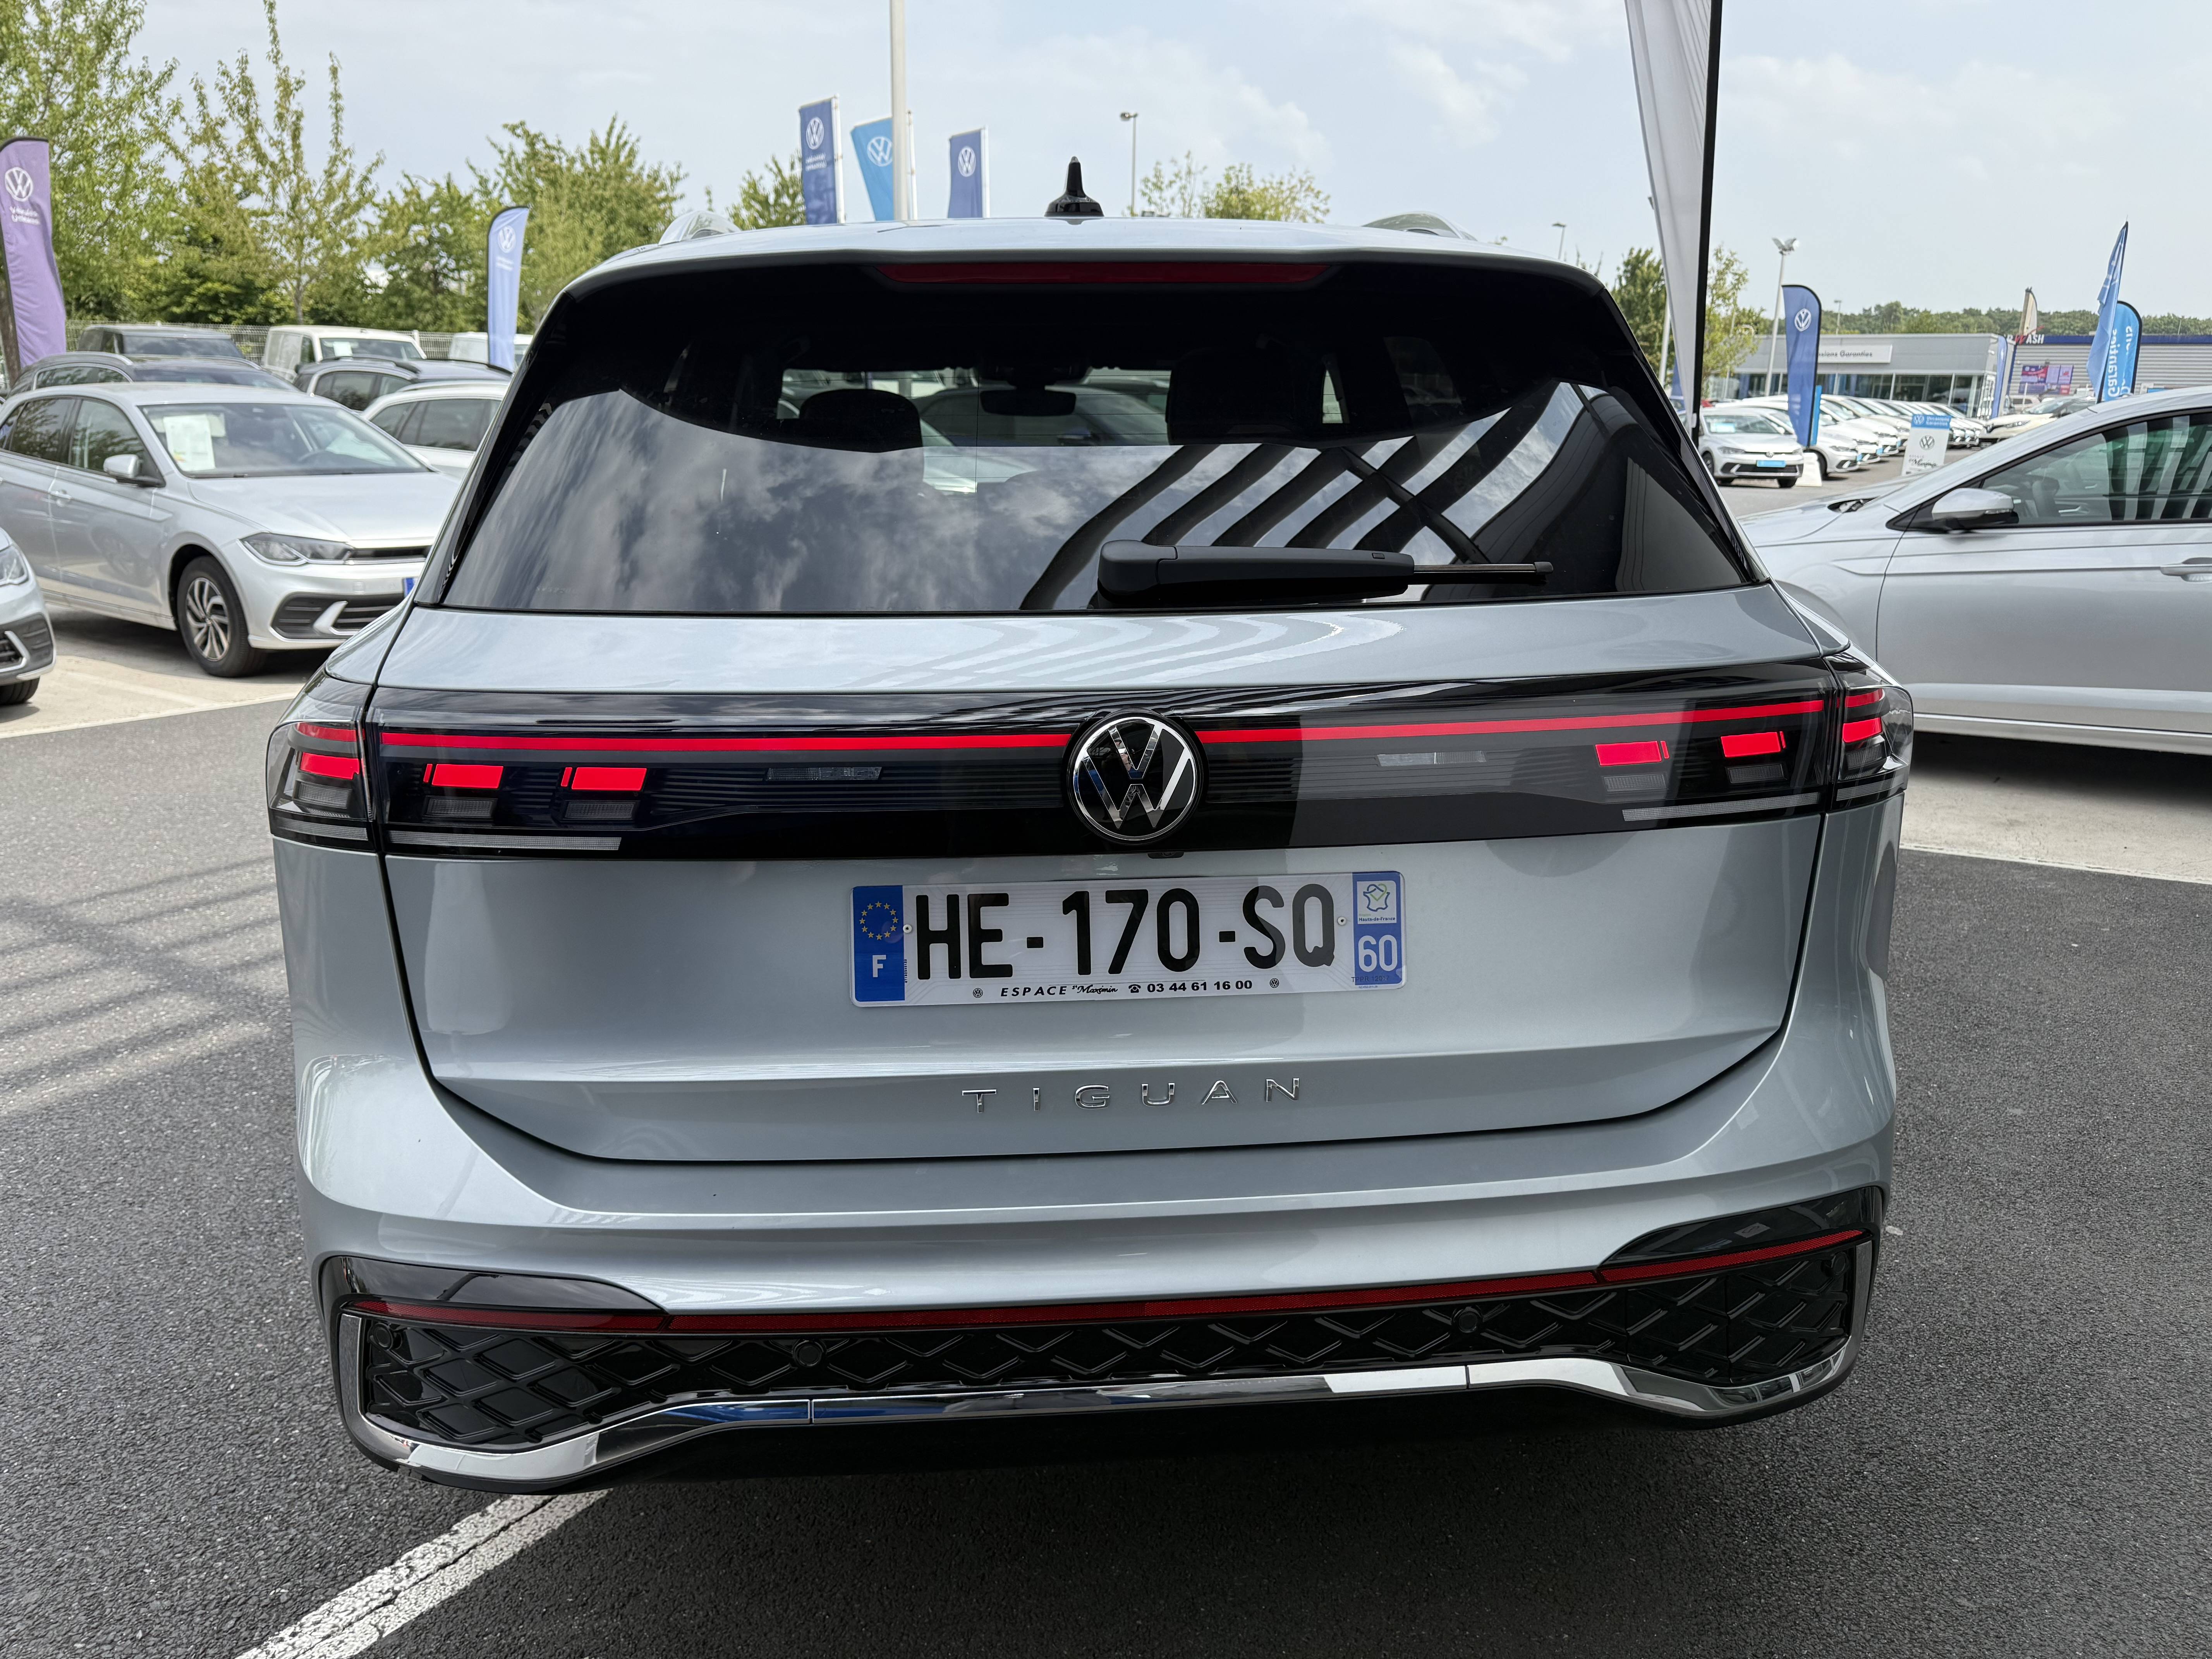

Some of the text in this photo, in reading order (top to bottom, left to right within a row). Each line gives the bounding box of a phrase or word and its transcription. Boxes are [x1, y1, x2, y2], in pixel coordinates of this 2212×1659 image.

[1358, 934, 1398, 972] 60
[872, 955, 886, 977] F
[1001, 986, 1066, 996] ESPACE
[1147, 980, 1252, 992] 03 44 61 16 00
[962, 1078, 1300, 1113] TIGUAN
